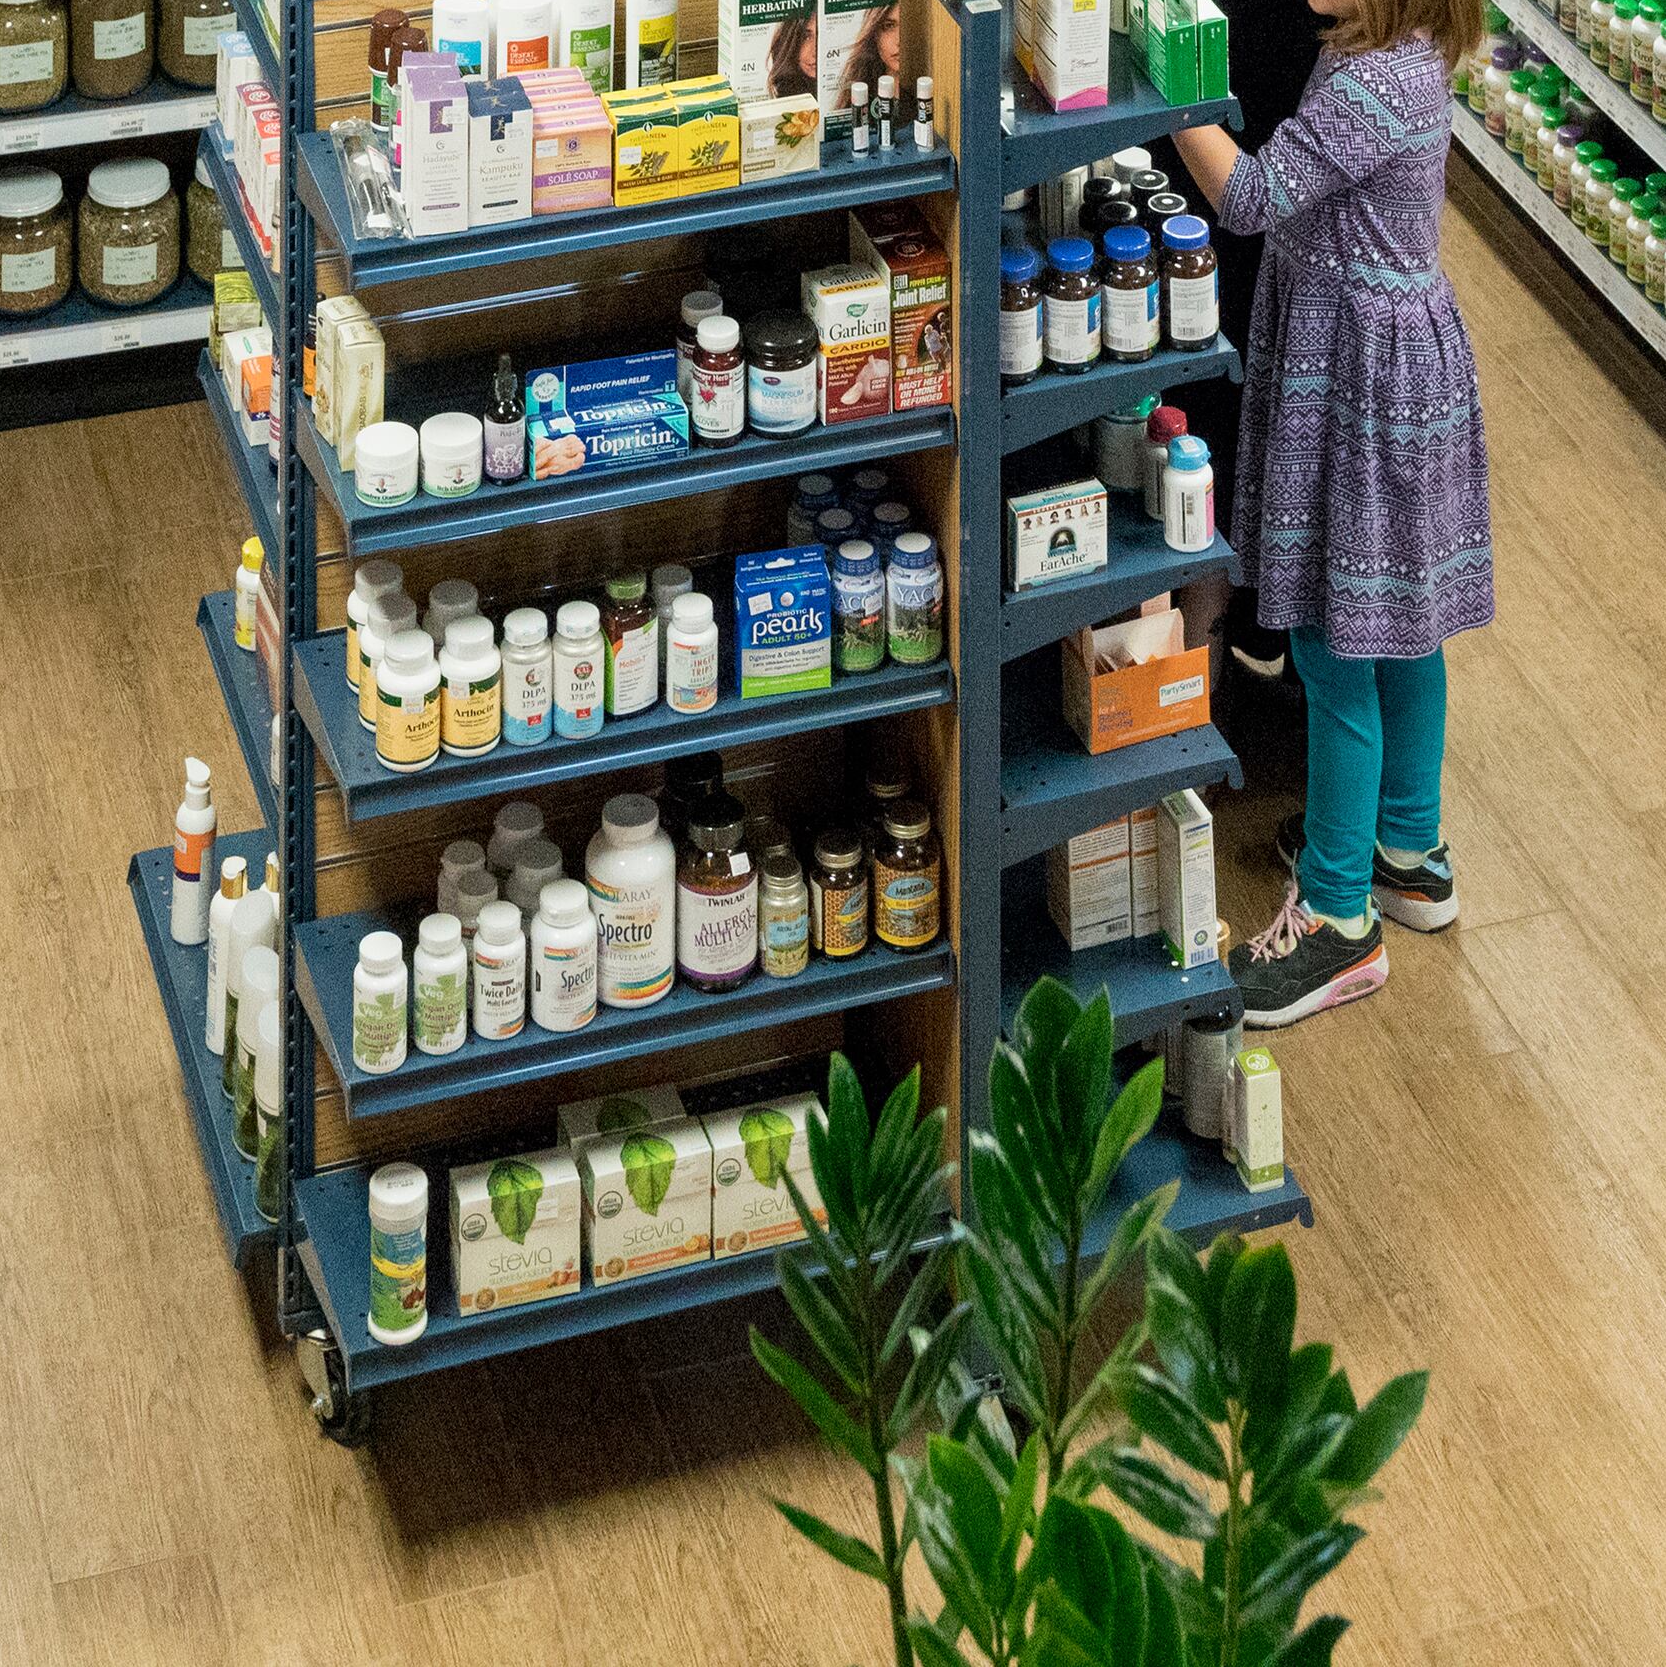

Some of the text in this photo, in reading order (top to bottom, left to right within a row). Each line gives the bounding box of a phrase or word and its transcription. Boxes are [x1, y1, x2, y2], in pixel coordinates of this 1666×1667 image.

[741, 26, 770, 34] PERMANENT
[573, 38, 598, 47] DESERT
[573, 44, 604, 53] ESSENCE
[826, 49, 840, 60] 6N
[741, 61, 755, 73] 4N
[479, 162, 524, 176] Kampuku
[572, 170, 598, 183] SOAP
[893, 284, 947, 308] Joint Relief
[829, 319, 887, 342] Garlicin
[829, 338, 887, 355] CARDIO
[571, 375, 651, 393] RAPID FOOT PAIN RELIEF
[900, 375, 944, 392] MUST HELP
[901, 385, 942, 399] OR MONEY
[901, 393, 943, 408] REFUNDED
[574, 401, 668, 424] Topricin
[586, 427, 675, 456] Topricin
[1040, 554, 1085, 572] EarAche
[767, 609, 808, 618] PROBIOTIC
[751, 608, 824, 646] pearls
[761, 631, 812, 645] ADULT 50+
[749, 651, 776, 662] Digestive
[784, 649, 801, 657] Colon
[802, 646, 825, 656] Support
[522, 687, 546, 700] DLPA
[570, 680, 596, 693] DLPA
[1160, 680, 1202, 697] PartySmart
[707, 893, 745, 907] TWINLAB
[598, 912, 652, 944] Spectro
[701, 906, 754, 935] ALLERGY
[694, 931, 731, 948] MULTI
[424, 986, 443, 1000] Veg
[480, 984, 504, 1000] Twice
[623, 1216, 685, 1247] stevia
[489, 1247, 553, 1276] stevia
